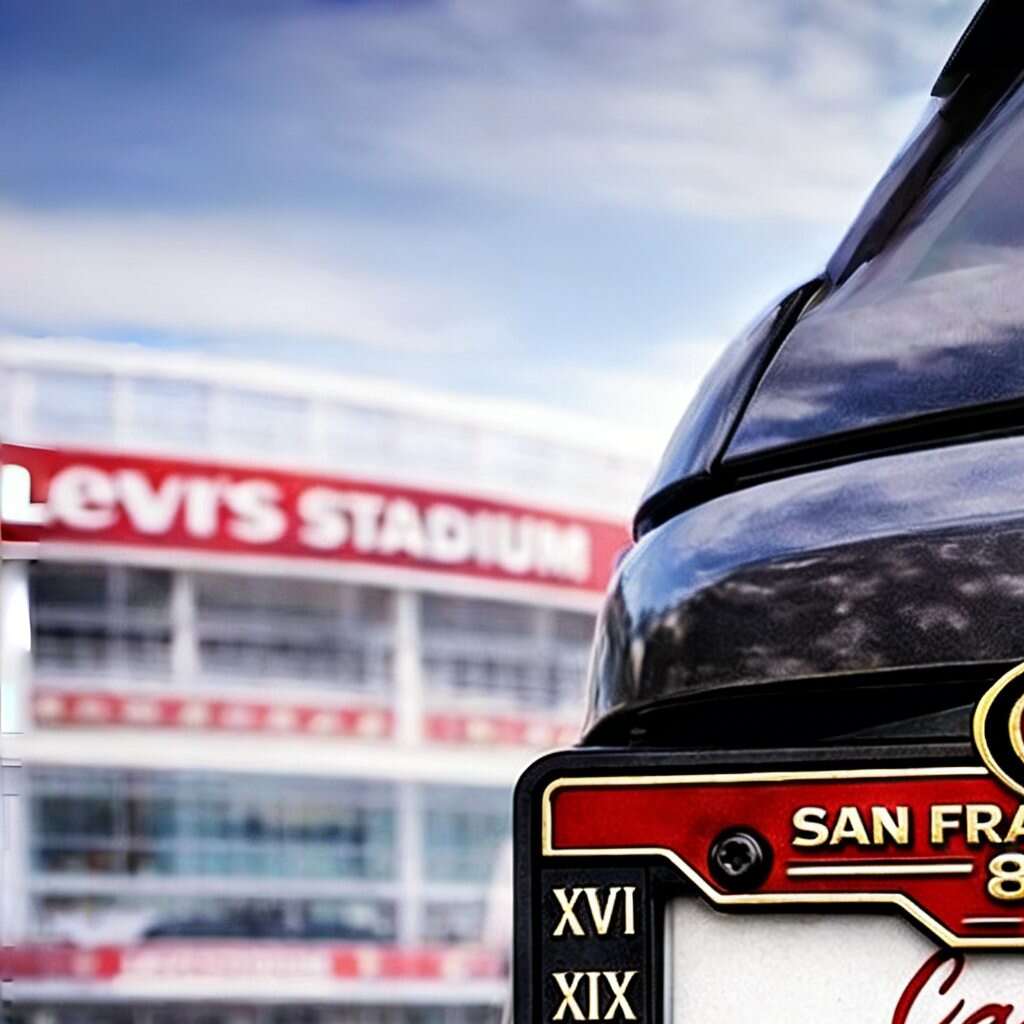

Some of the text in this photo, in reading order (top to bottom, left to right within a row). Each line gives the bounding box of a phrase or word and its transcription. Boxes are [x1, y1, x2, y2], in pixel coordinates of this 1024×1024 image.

[299, 486, 591, 582] STADIUM
[791, 803, 910, 847] SAN
[552, 886, 637, 937] XVI
[551, 969, 640, 1022] XIX
